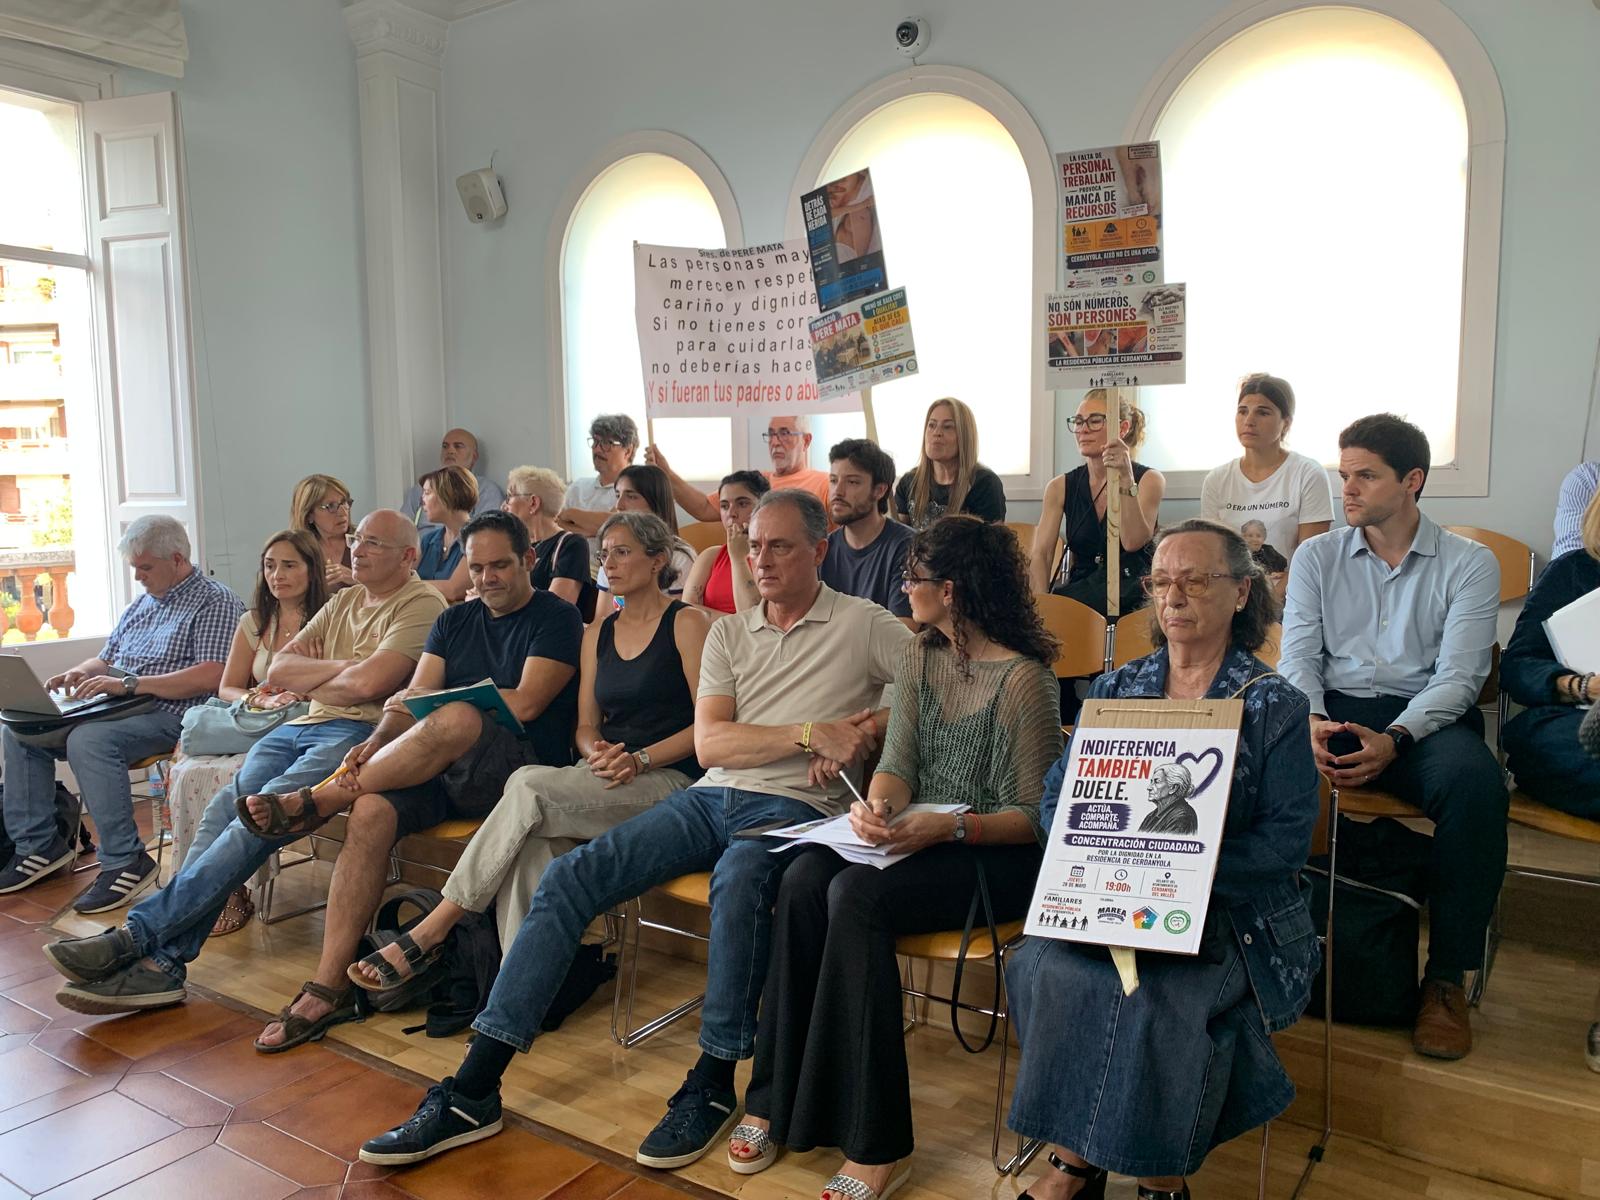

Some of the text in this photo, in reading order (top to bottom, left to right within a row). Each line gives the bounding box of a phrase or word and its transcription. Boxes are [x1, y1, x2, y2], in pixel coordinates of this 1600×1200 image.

[1070, 154, 1077, 162] LA
[1095, 151, 1102, 159] DE
[1063, 158, 1114, 176] PERSONAL
[1063, 171, 1116, 188] TREBALLANT
[1065, 190, 1117, 207] MANCA DE
[1066, 202, 1117, 219] RECURSOS
[720, 249, 730, 258] de
[732, 248, 756, 258] PERE
[756, 242, 785, 255] MATA
[649, 253, 678, 269] Las
[687, 257, 765, 273] personas
[670, 279, 745, 292] merecen
[663, 297, 724, 312] cariño
[734, 301, 741, 315] y
[1048, 302, 1060, 313] NO
[1063, 298, 1081, 311] SÓN
[653, 316, 812, 332] Si no tienes cor
[1076, 308, 1137, 324] PERSONES
[814, 315, 857, 340] PERE MATA
[676, 340, 716, 354] para
[652, 361, 670, 374] no
[680, 359, 761, 373] deberías
[1055, 359, 1063, 367] LA
[658, 381, 668, 403] si
[672, 380, 710, 403] fueran
[714, 379, 732, 402] tus
[737, 379, 781, 408] padres
[786, 385, 793, 401] o
[1079, 739, 1176, 757] INDIFERENCIA
[1077, 757, 1152, 779] TAMBIÉN
[1072, 780, 1128, 800] DUELE.
[1078, 820, 1119, 830] ACOMPAÑA.
[1080, 812, 1120, 822] COMPARTE,
[1071, 835, 1200, 853] CONCENTRACIÓN CIUDADANA
[1086, 855, 1171, 867] RESIDENCIA DE CERDANYOLA
[1118, 850, 1144, 858] DIGNIDAD
[1105, 881, 1131, 893] 19:00h
[1043, 895, 1082, 905] FAMILIARES
[1097, 906, 1127, 917] MAREA
